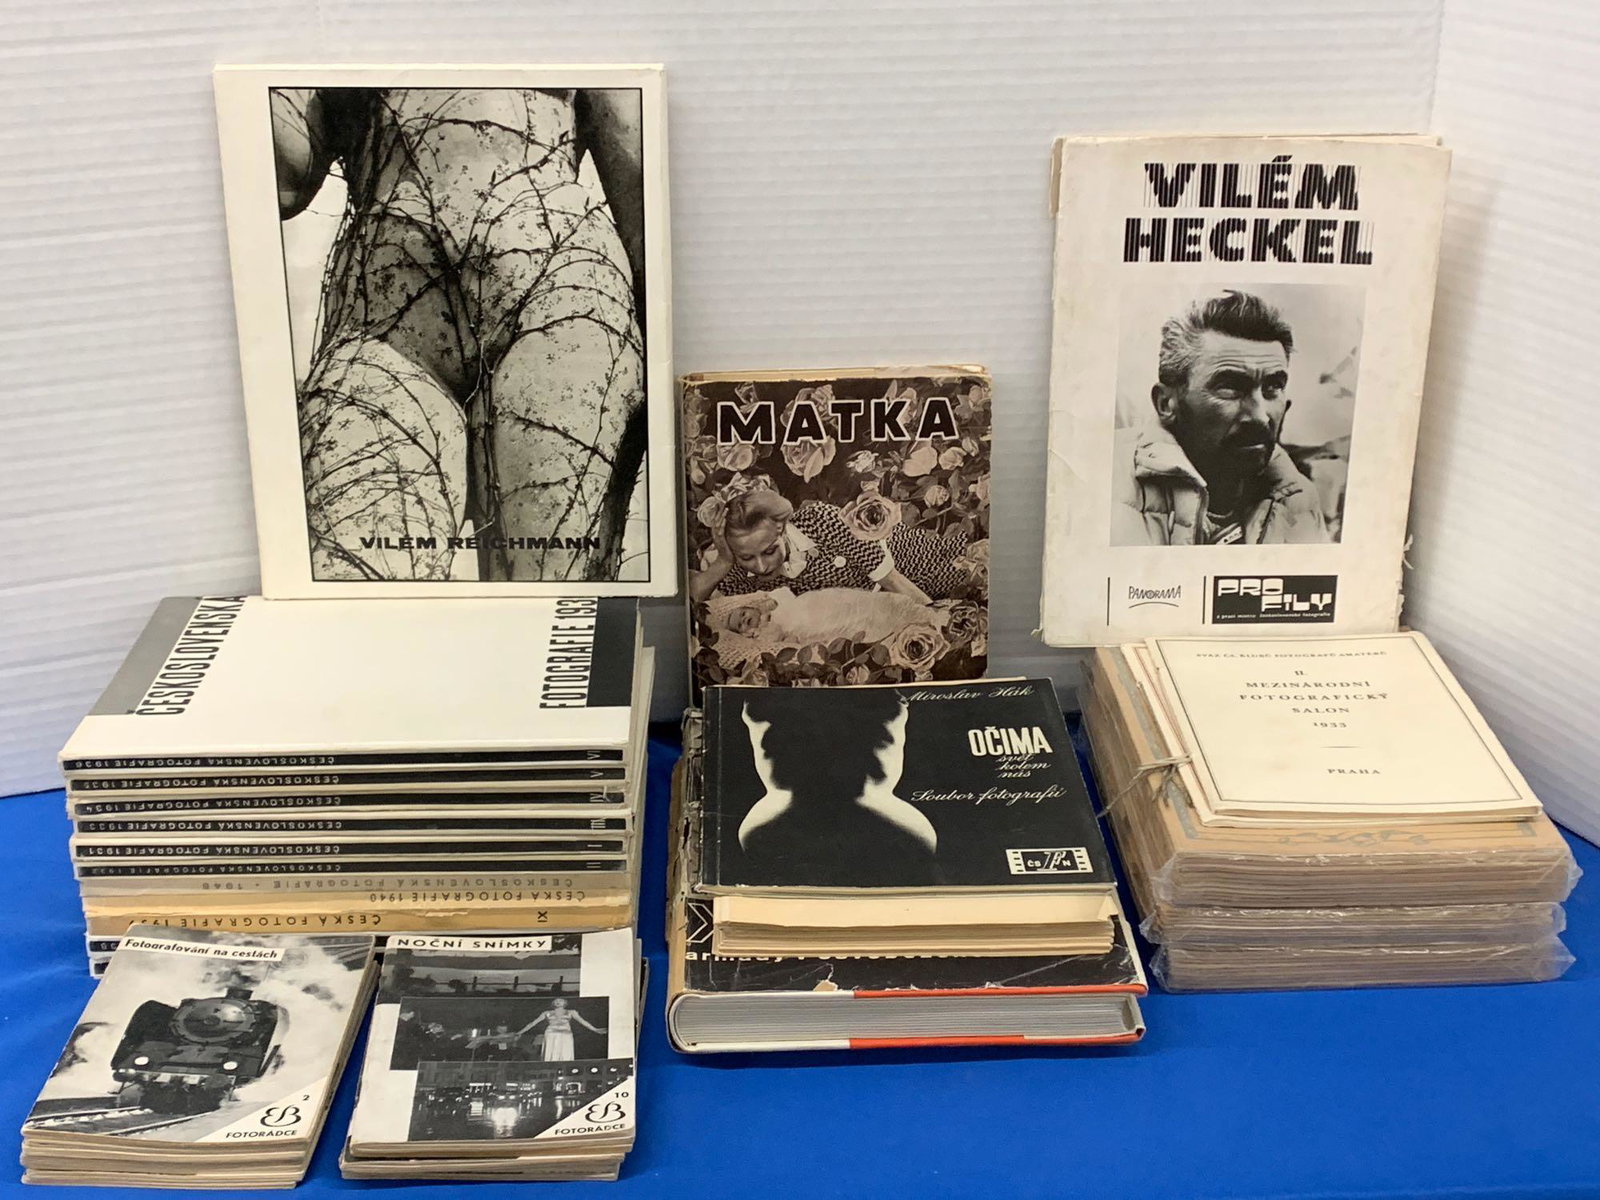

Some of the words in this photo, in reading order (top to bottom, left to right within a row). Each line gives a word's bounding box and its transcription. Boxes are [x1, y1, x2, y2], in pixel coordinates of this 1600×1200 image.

[1143, 155, 1361, 210] VILÉM
[1123, 217, 1375, 265] HECKEL
[716, 397, 959, 446] MATKA
[447, 536, 600, 550] REICHMANN
[1128, 585, 1181, 599] PANORAMA
[1218, 578, 1284, 597] PRO
[554, 598, 599, 618] 193
[539, 622, 590, 708] FOTOGRAFIE
[1246, 680, 1372, 689] MEZINÁRODNÍ
[908, 688, 982, 701] Miroslav
[1239, 692, 1389, 701] FOTOGRAFICKÝ
[968, 726, 1053, 756] OČIMA
[75, 760, 108, 768] 1936
[114, 759, 201, 768] FOTOGRAFIE
[995, 761, 1051, 771] kolem
[997, 769, 1031, 778] nás
[120, 779, 207, 787] FOTOGRAFIE
[911, 789, 976, 802] Soubor
[124, 801, 209, 810] FOTOGRAFIE
[88, 822, 123, 831] 1933
[127, 822, 212, 831] FOTOGRAFIE
[88, 847, 120, 855] 1931
[125, 846, 209, 855] FOTOGRAFIE
[128, 866, 213, 874] FOTOGRAFIE
[273, 879, 385, 889] FOTOGRAFIE
[369, 892, 404, 903] 1940
[411, 891, 522, 902] FOTOGRAFIE
[531, 890, 585, 902] ČESKÁ
[180, 914, 308, 927] FOTOGRAFIE
[318, 914, 382, 927] ČESKÁ
[124, 938, 209, 955] Fotografování
[213, 947, 229, 957] na
[231, 947, 278, 959] cestách
[397, 937, 463, 948] NOČNÍ
[473, 938, 546, 949] SNÍMKY
